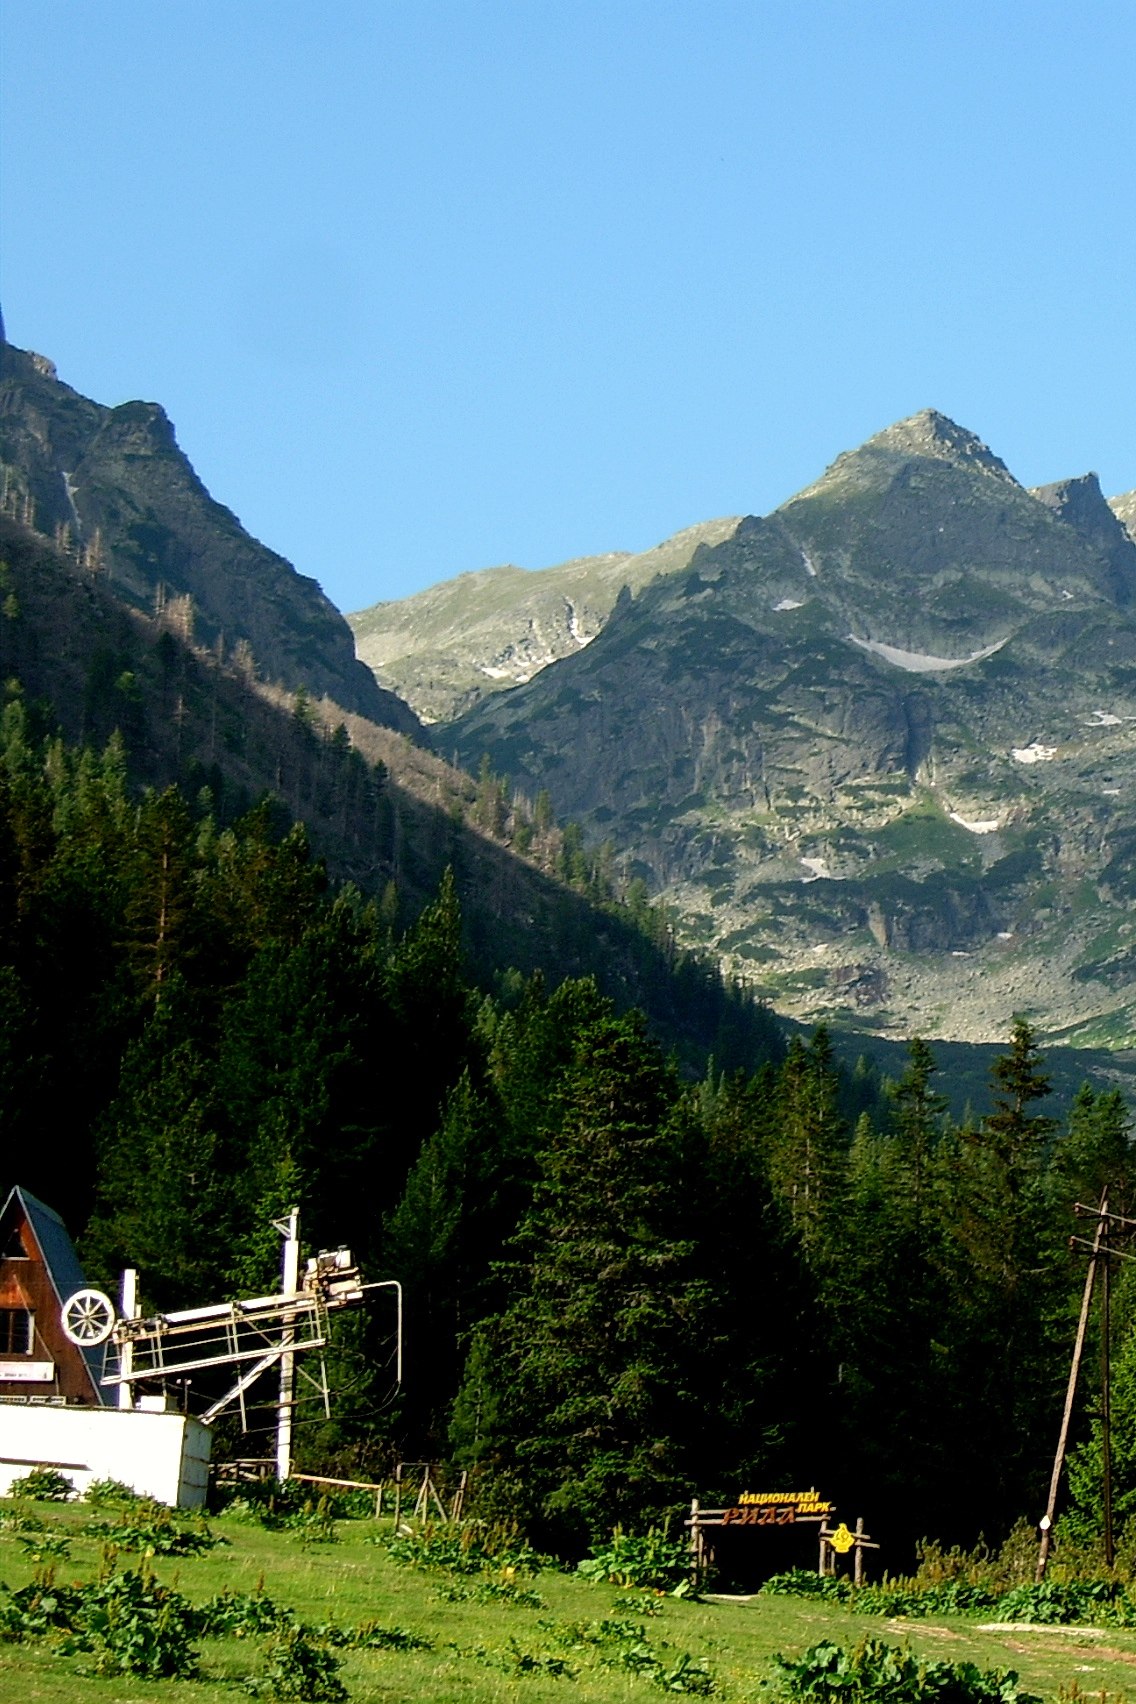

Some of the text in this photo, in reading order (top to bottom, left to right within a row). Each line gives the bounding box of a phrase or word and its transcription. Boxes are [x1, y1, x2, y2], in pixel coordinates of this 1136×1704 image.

[738, 1492, 821, 1505] НАЦИОНАЛЕН
[797, 1502, 831, 1513] ПАРК
[721, 1507, 796, 1526] РИЛА
